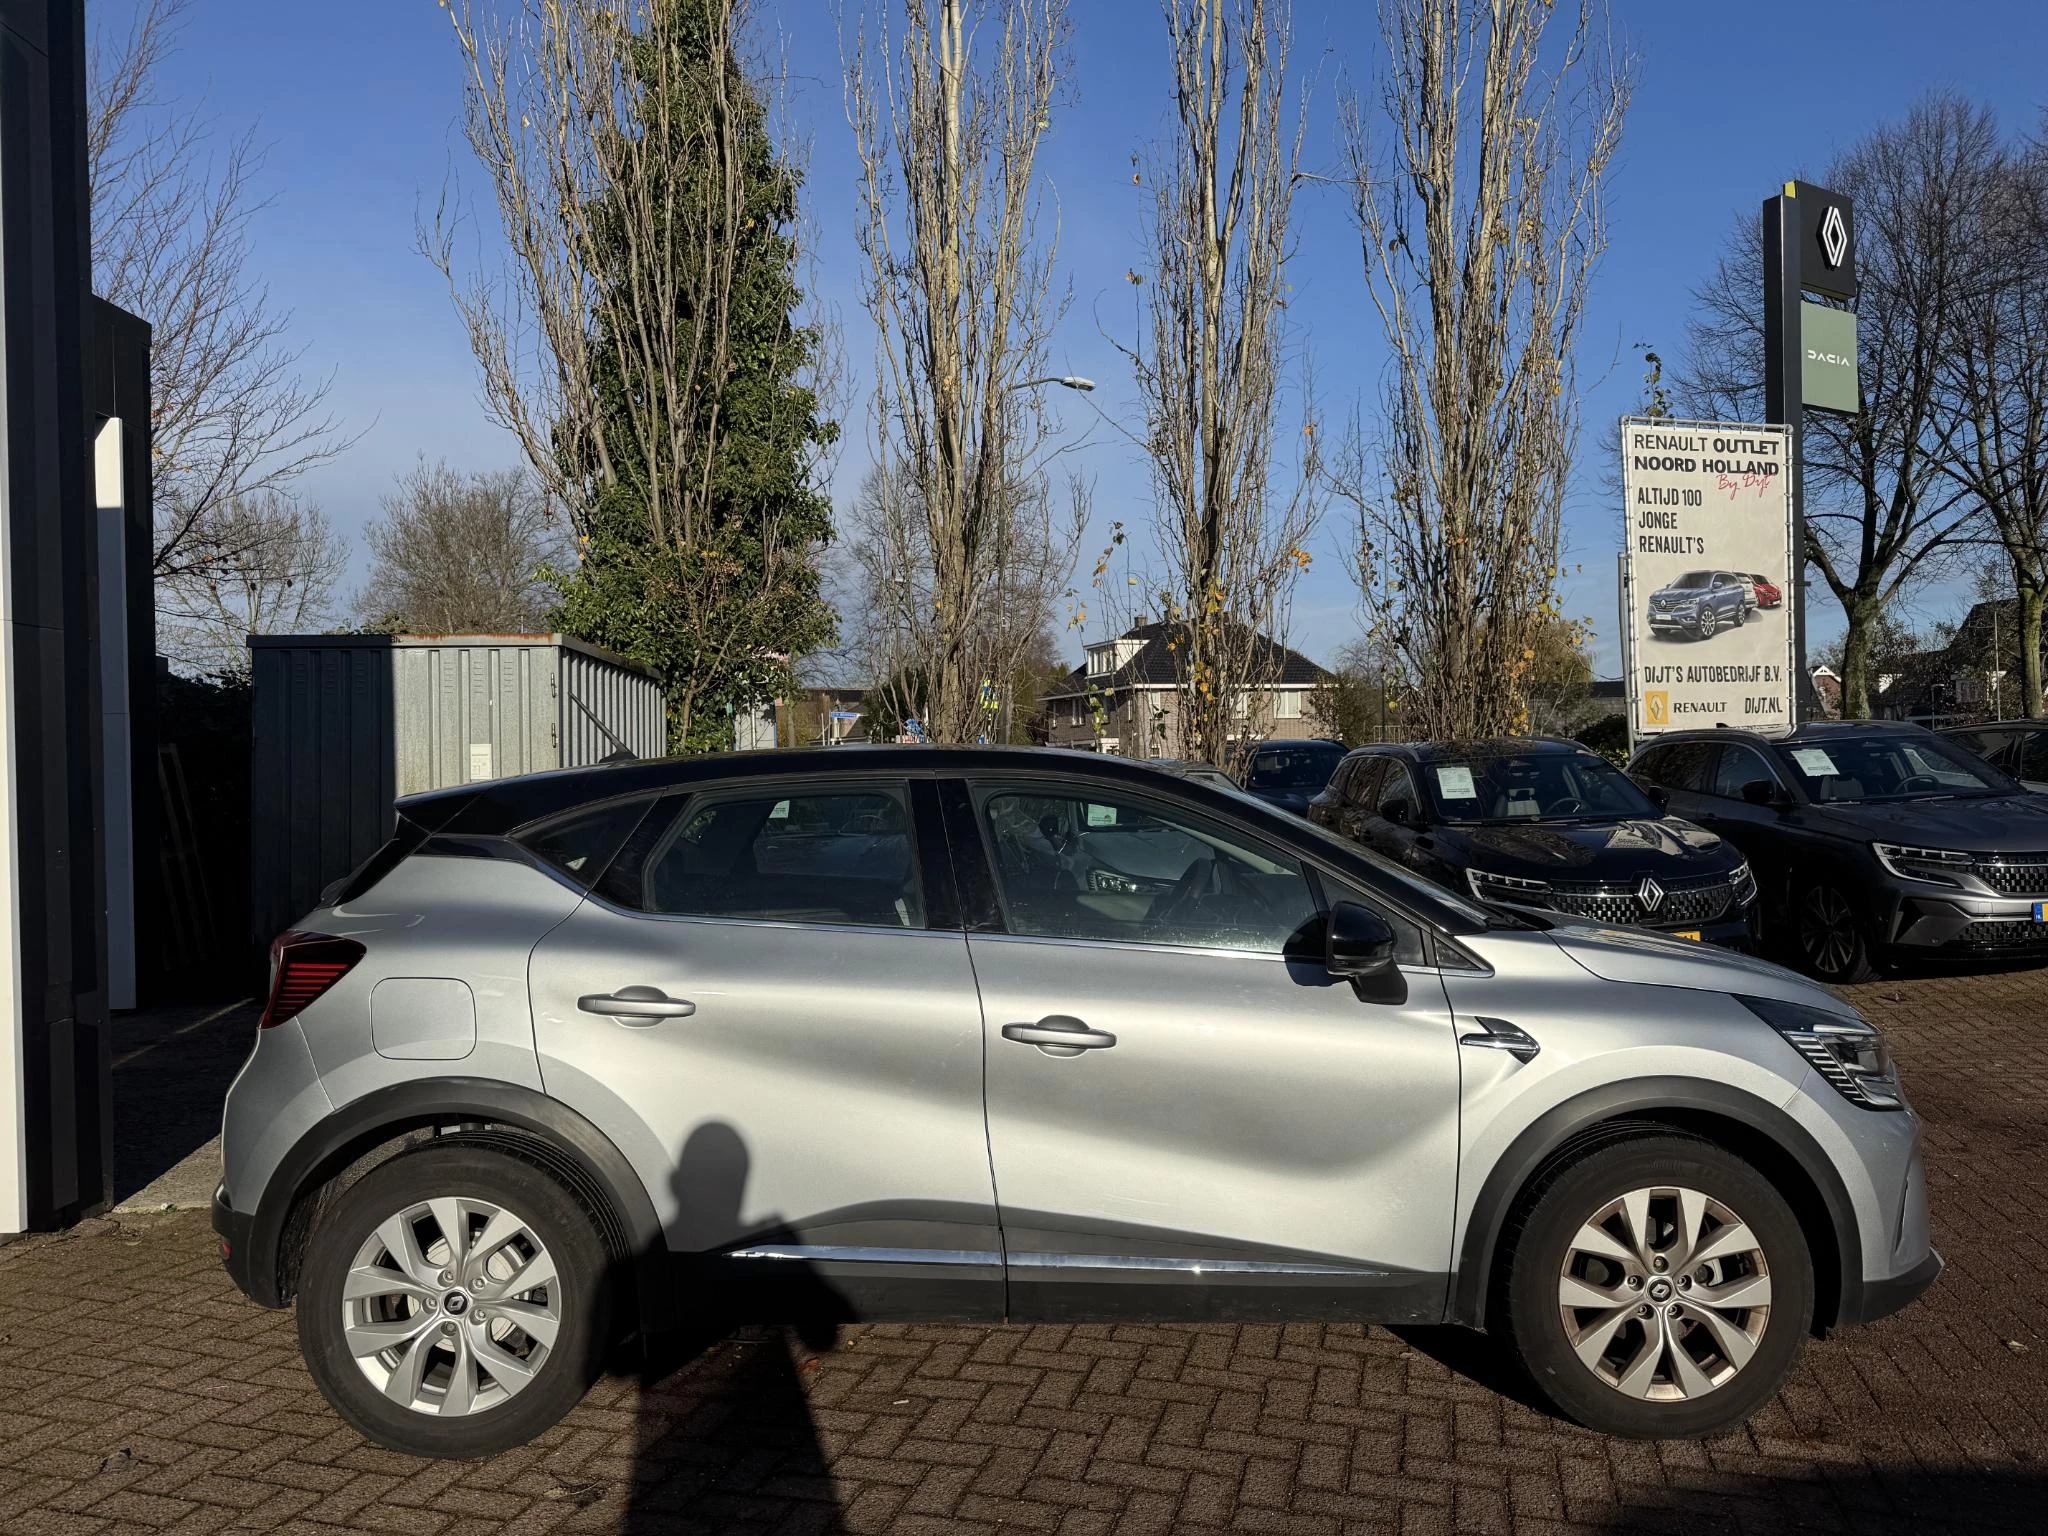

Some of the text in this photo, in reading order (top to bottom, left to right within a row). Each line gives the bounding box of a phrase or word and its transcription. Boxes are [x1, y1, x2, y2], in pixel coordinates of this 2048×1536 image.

[1807, 350, 1850, 366] DACIA
[1634, 434, 1780, 455] RENAULT OUTLET
[1634, 456, 1780, 475] NOORD HOLLAND
[1716, 473, 1740, 500] By
[1638, 487, 1702, 506] ALTIJD 100
[1638, 511, 1678, 529] JONGE
[1639, 535, 1705, 554] RENAULT'S
[1644, 665, 1782, 683] DIJT'S AUTOBEDRIJF B.V.
[1673, 697, 1783, 714] RENAULT DIJT.NL
